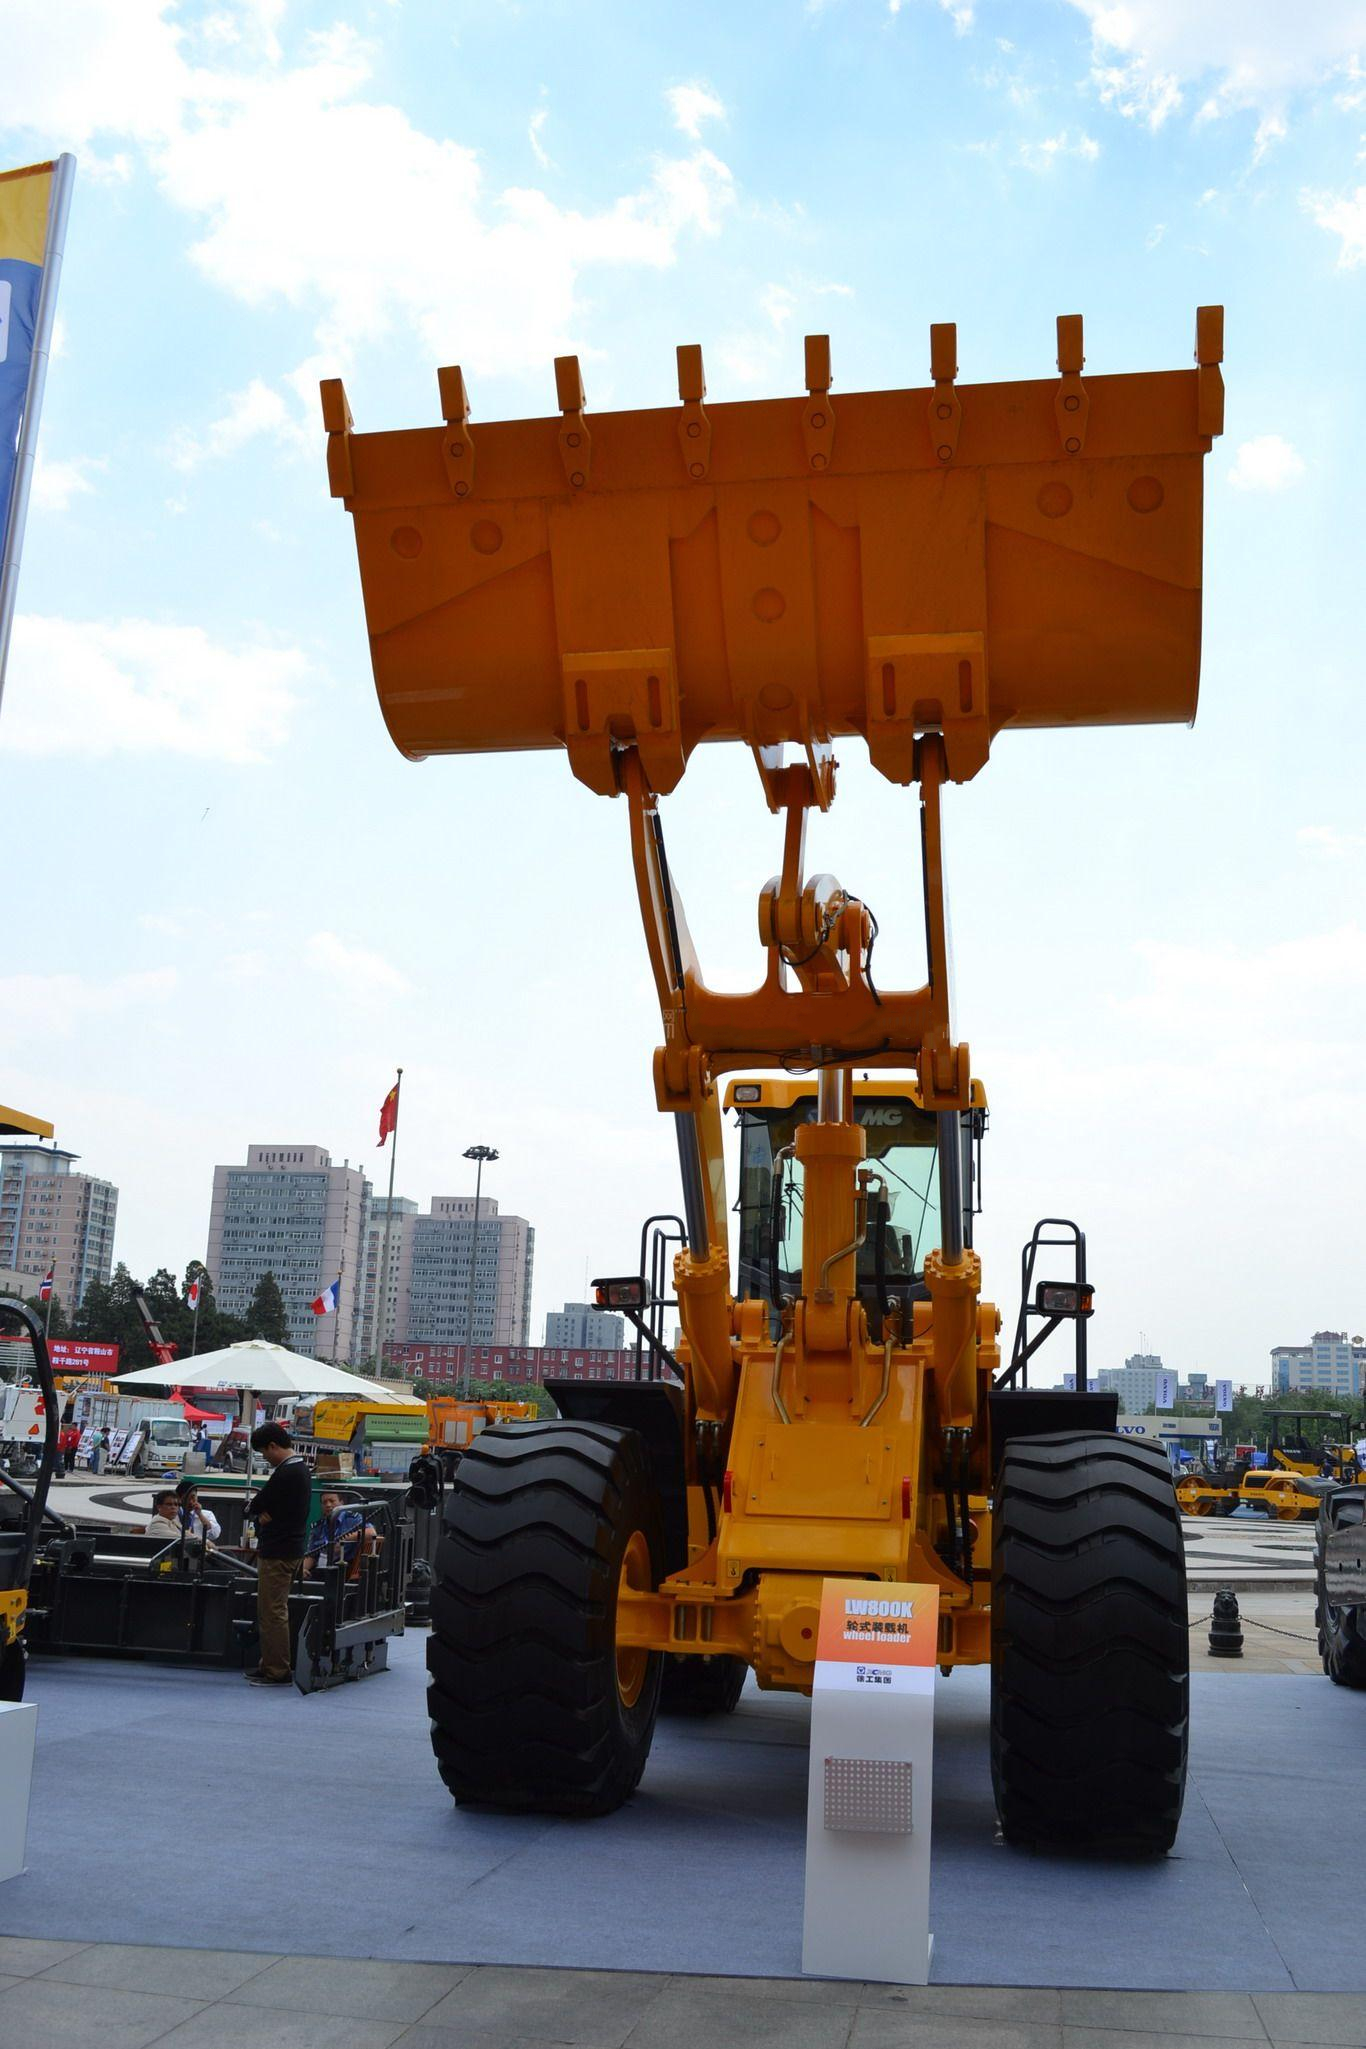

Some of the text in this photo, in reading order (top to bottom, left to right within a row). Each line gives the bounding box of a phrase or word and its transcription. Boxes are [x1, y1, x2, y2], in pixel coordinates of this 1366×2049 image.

[1115, 1425, 1146, 1434] LVO
[846, 1620, 909, 1634] 轮式装载机
[843, 1631, 912, 1643] wheel loader
